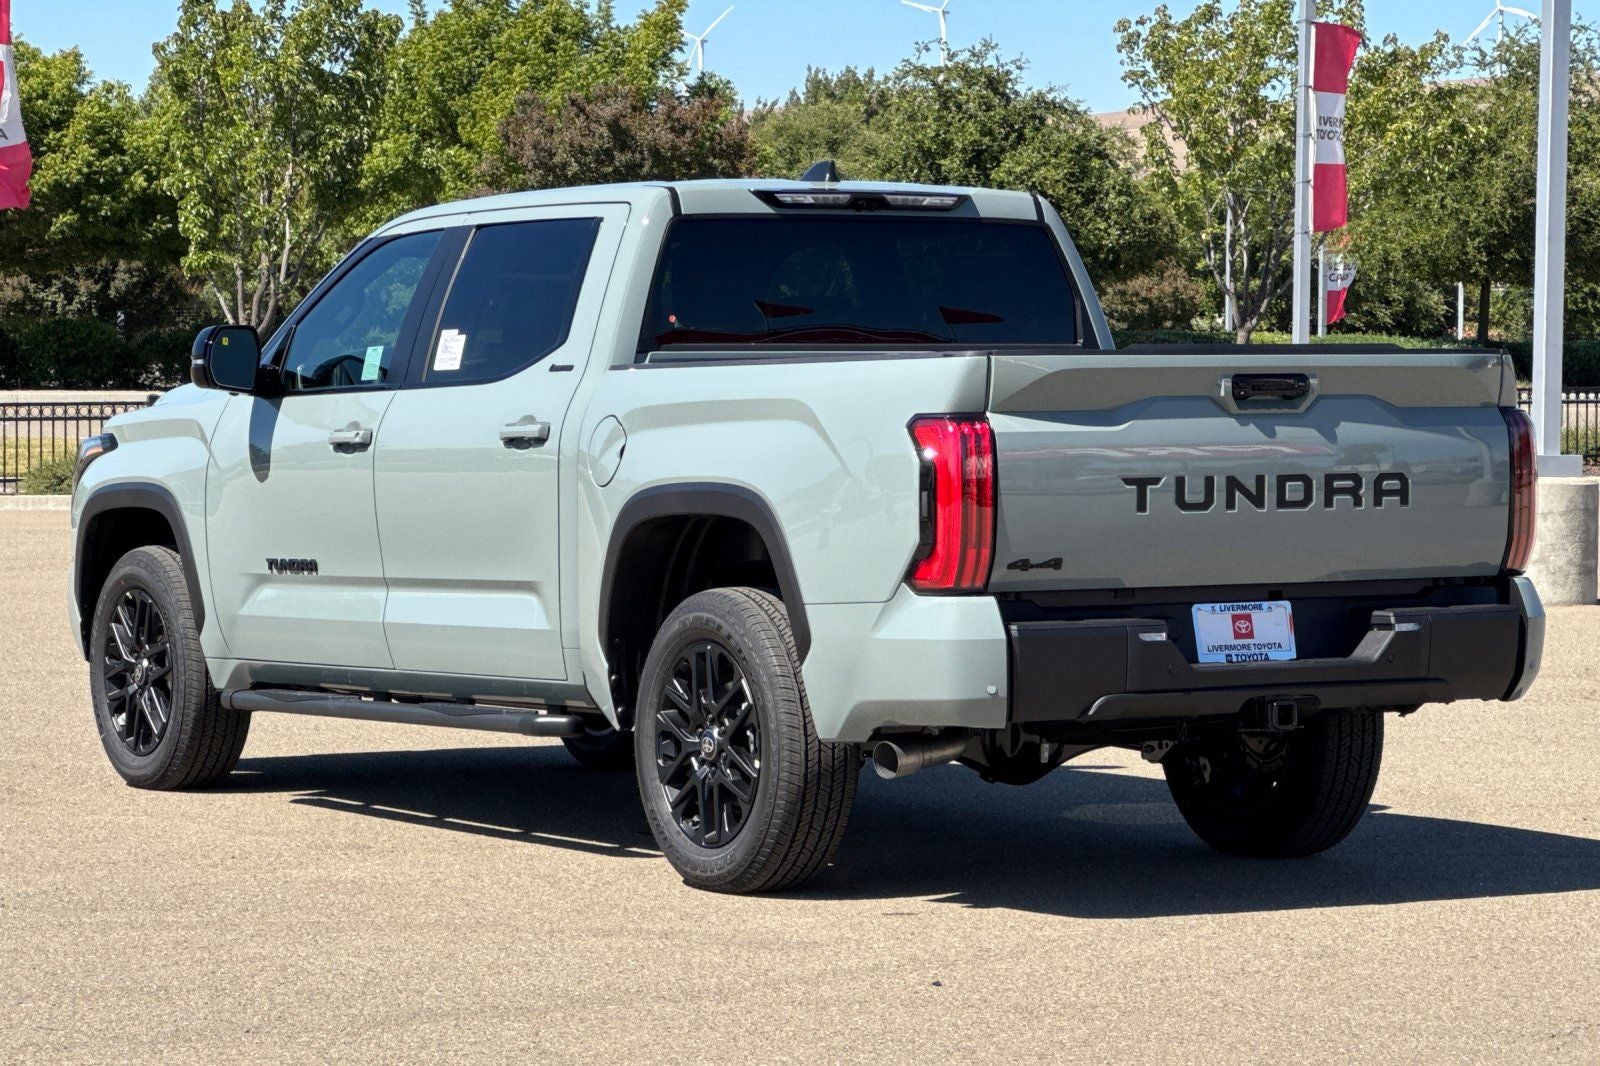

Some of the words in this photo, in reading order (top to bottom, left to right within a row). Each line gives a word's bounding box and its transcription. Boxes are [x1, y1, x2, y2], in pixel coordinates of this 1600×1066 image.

[1120, 472, 1411, 514] TUNDRA
[265, 558, 319, 573] TUNDRA
[1219, 603, 1264, 613] LIVERMORE
[1207, 644, 1252, 653] LIVERMORE
[1253, 642, 1283, 651] TOYOTA
[1234, 653, 1270, 663] TOYOTA
